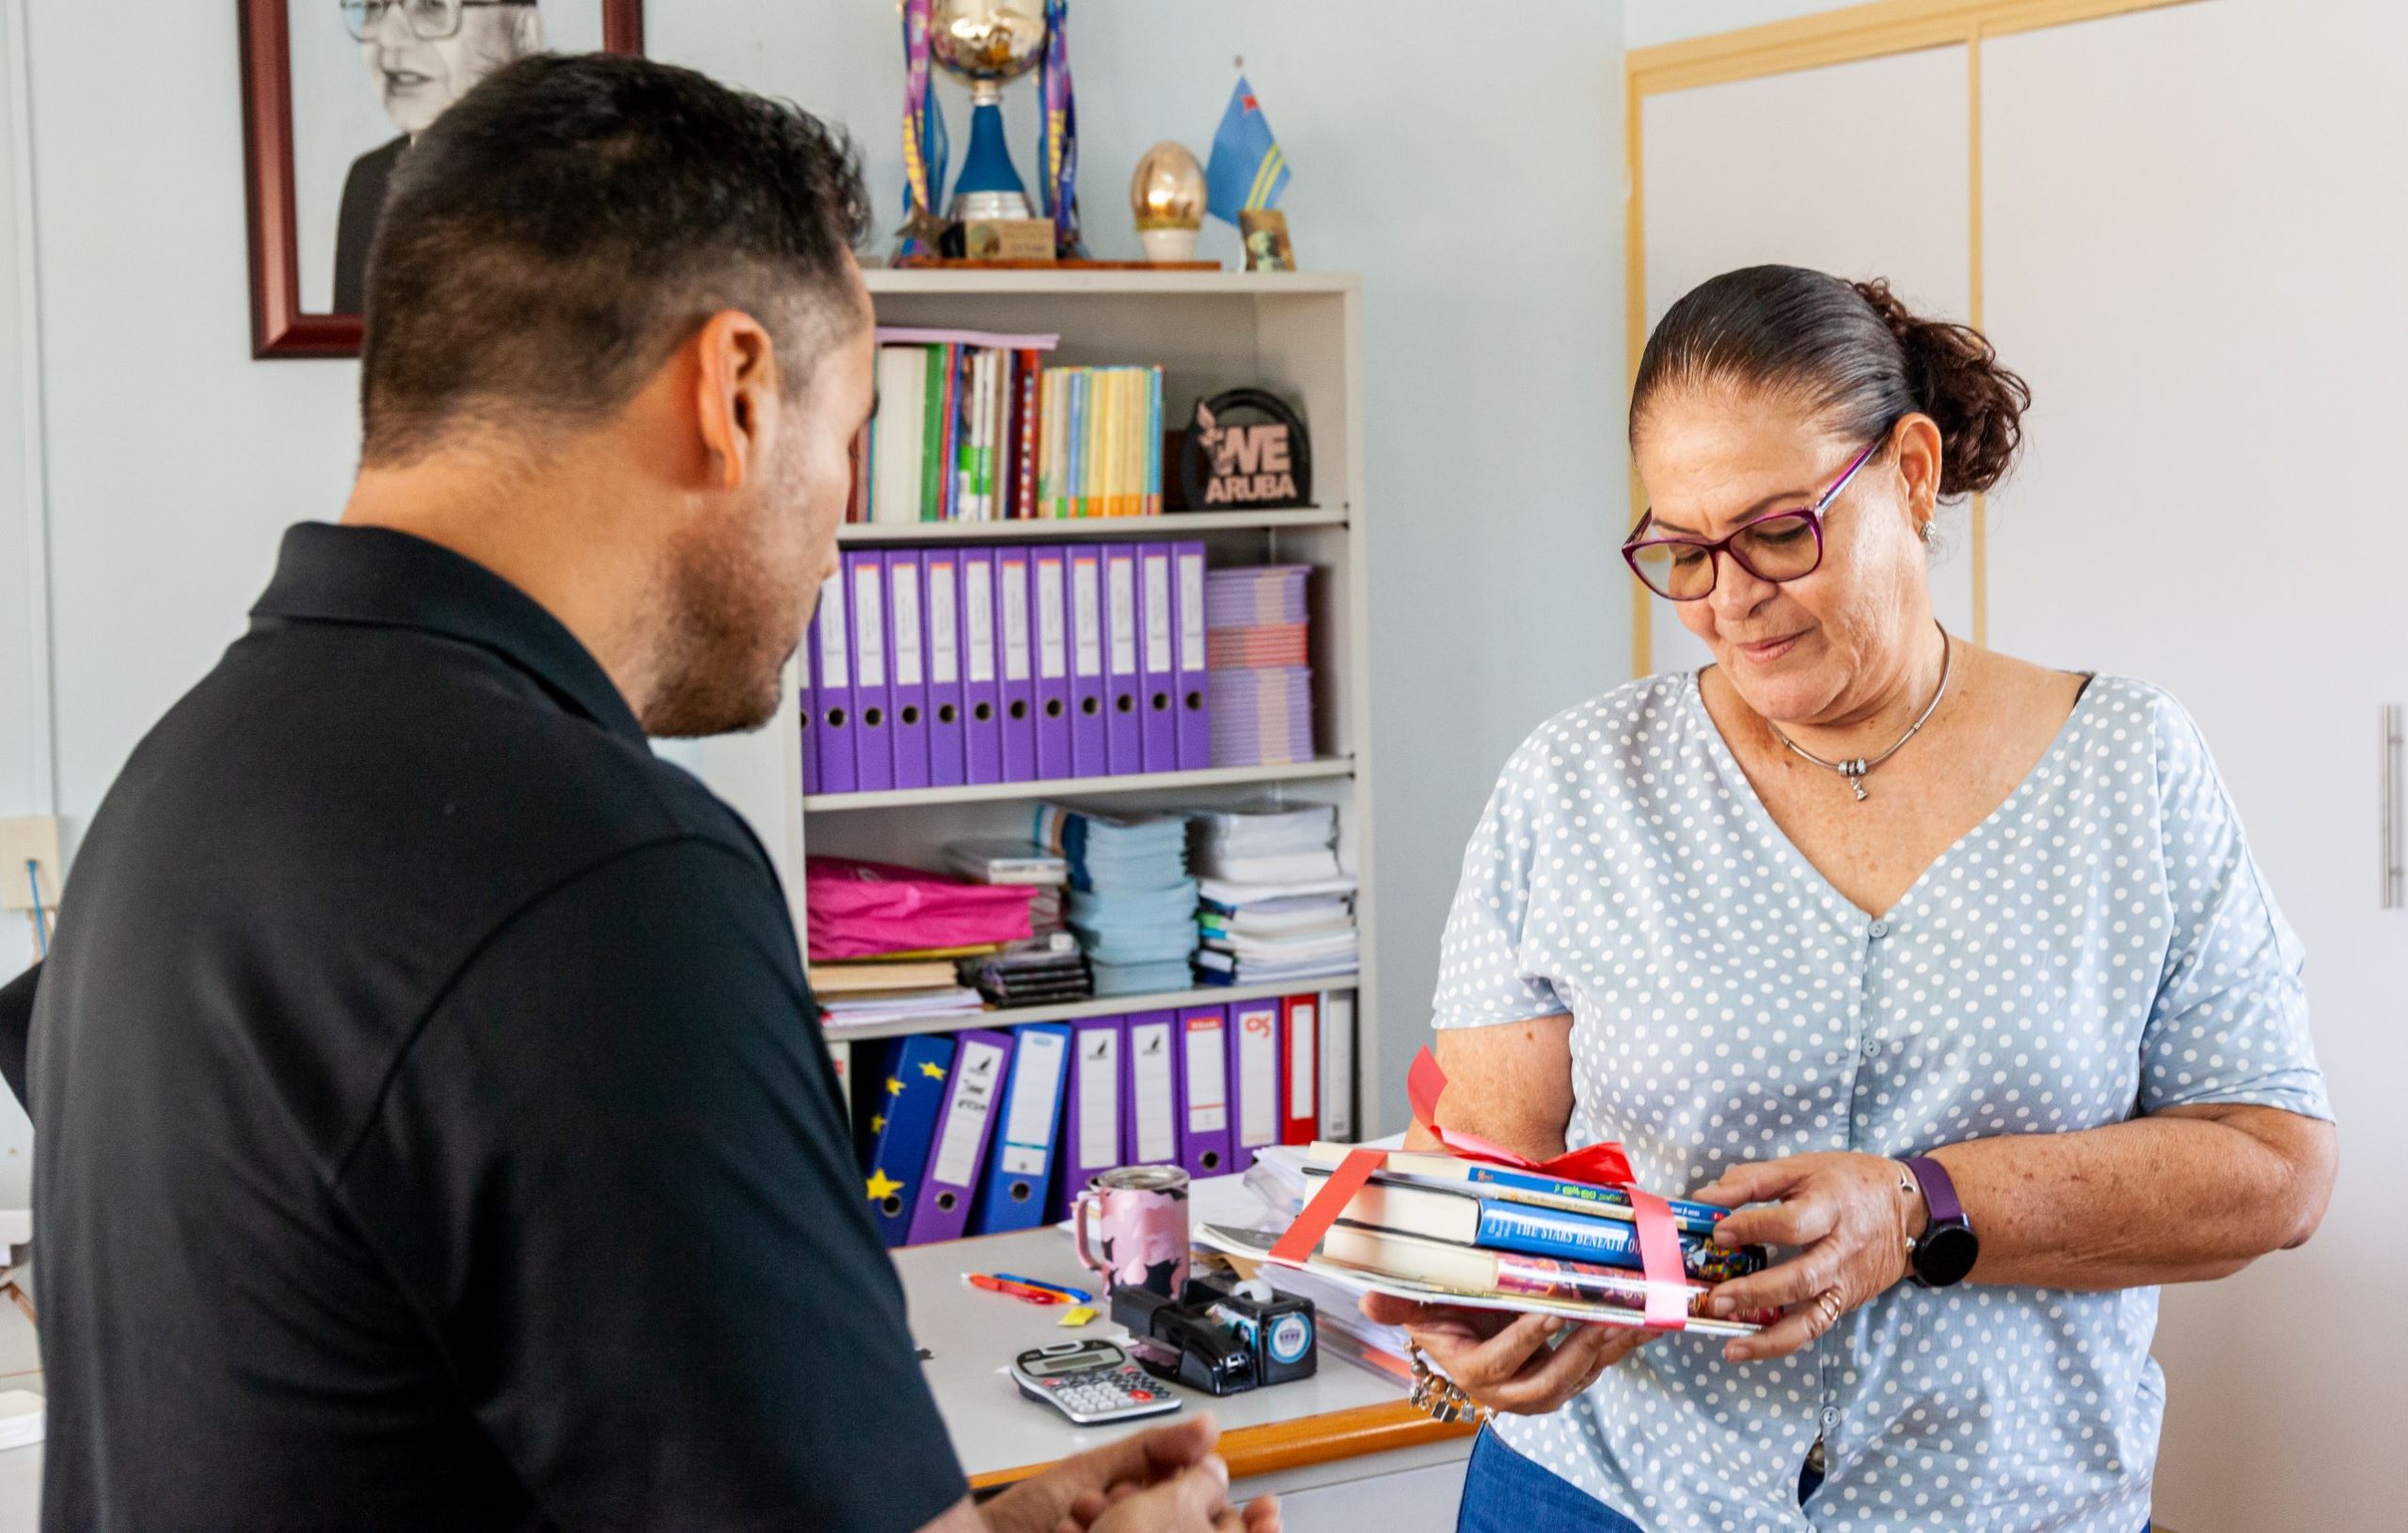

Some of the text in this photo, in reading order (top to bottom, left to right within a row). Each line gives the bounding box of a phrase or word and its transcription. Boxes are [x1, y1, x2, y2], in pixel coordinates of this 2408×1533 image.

[1205, 474, 1298, 504] ARUBA
[1515, 1220, 1540, 1238] THE
[1541, 1224, 1574, 1243] STARS
[1576, 1227, 1625, 1253] BENEATH
[1627, 1236, 1642, 1255] OU
